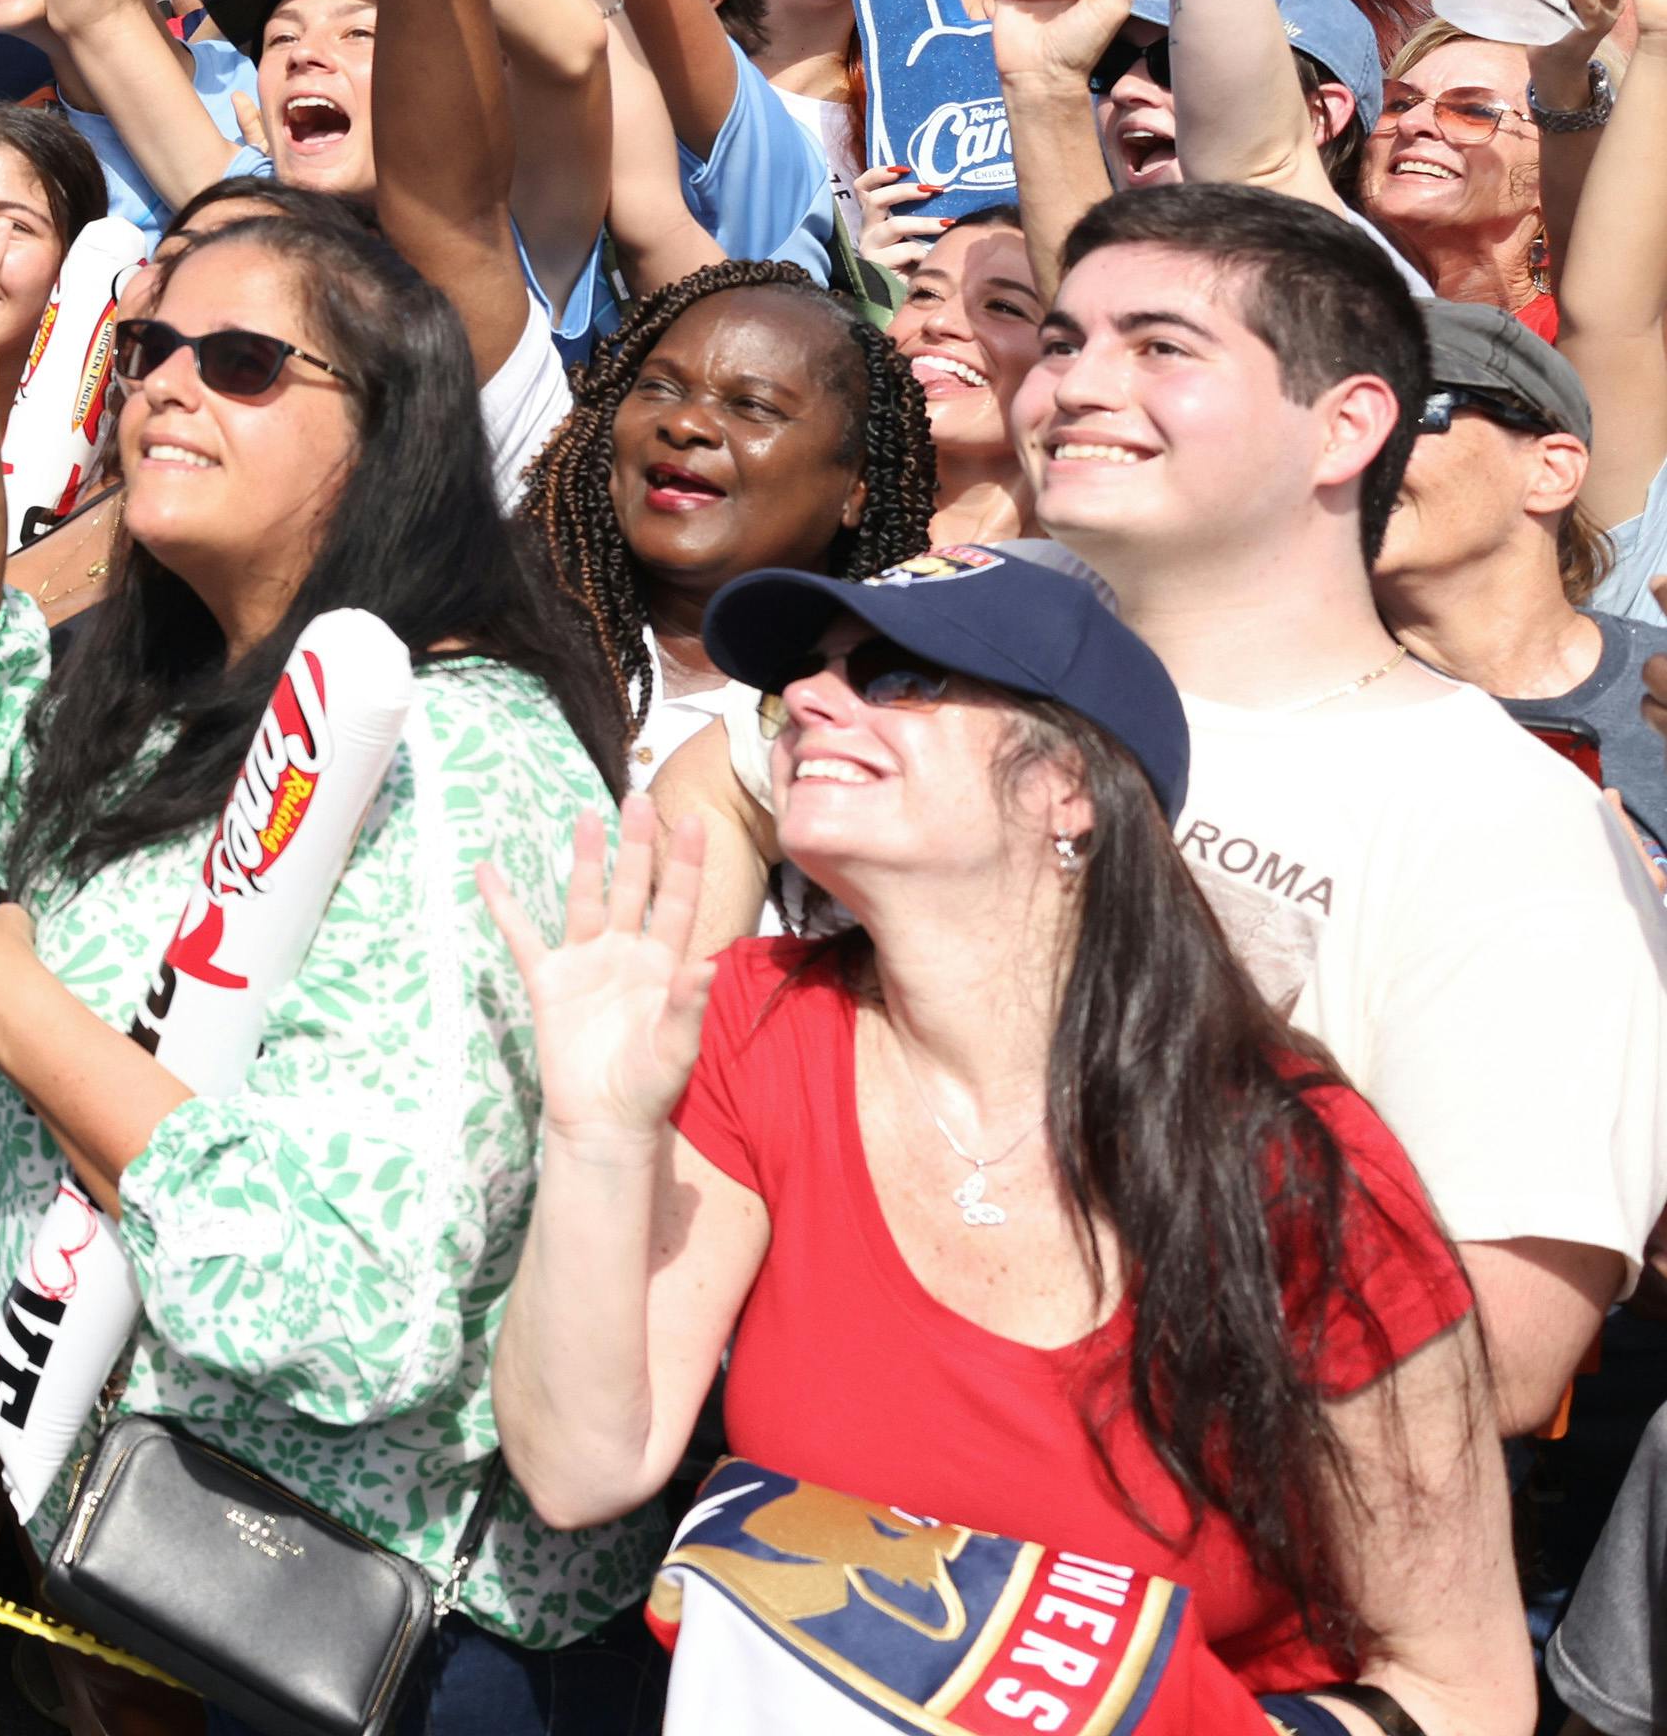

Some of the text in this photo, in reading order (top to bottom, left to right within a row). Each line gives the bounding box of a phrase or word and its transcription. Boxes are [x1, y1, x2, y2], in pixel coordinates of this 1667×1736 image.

[73, 320, 115, 424] CHICKEN FINGERS
[211, 648, 333, 899] Cane's
[259, 767, 314, 854] Raising
[1179, 819, 1334, 916] ROMA
